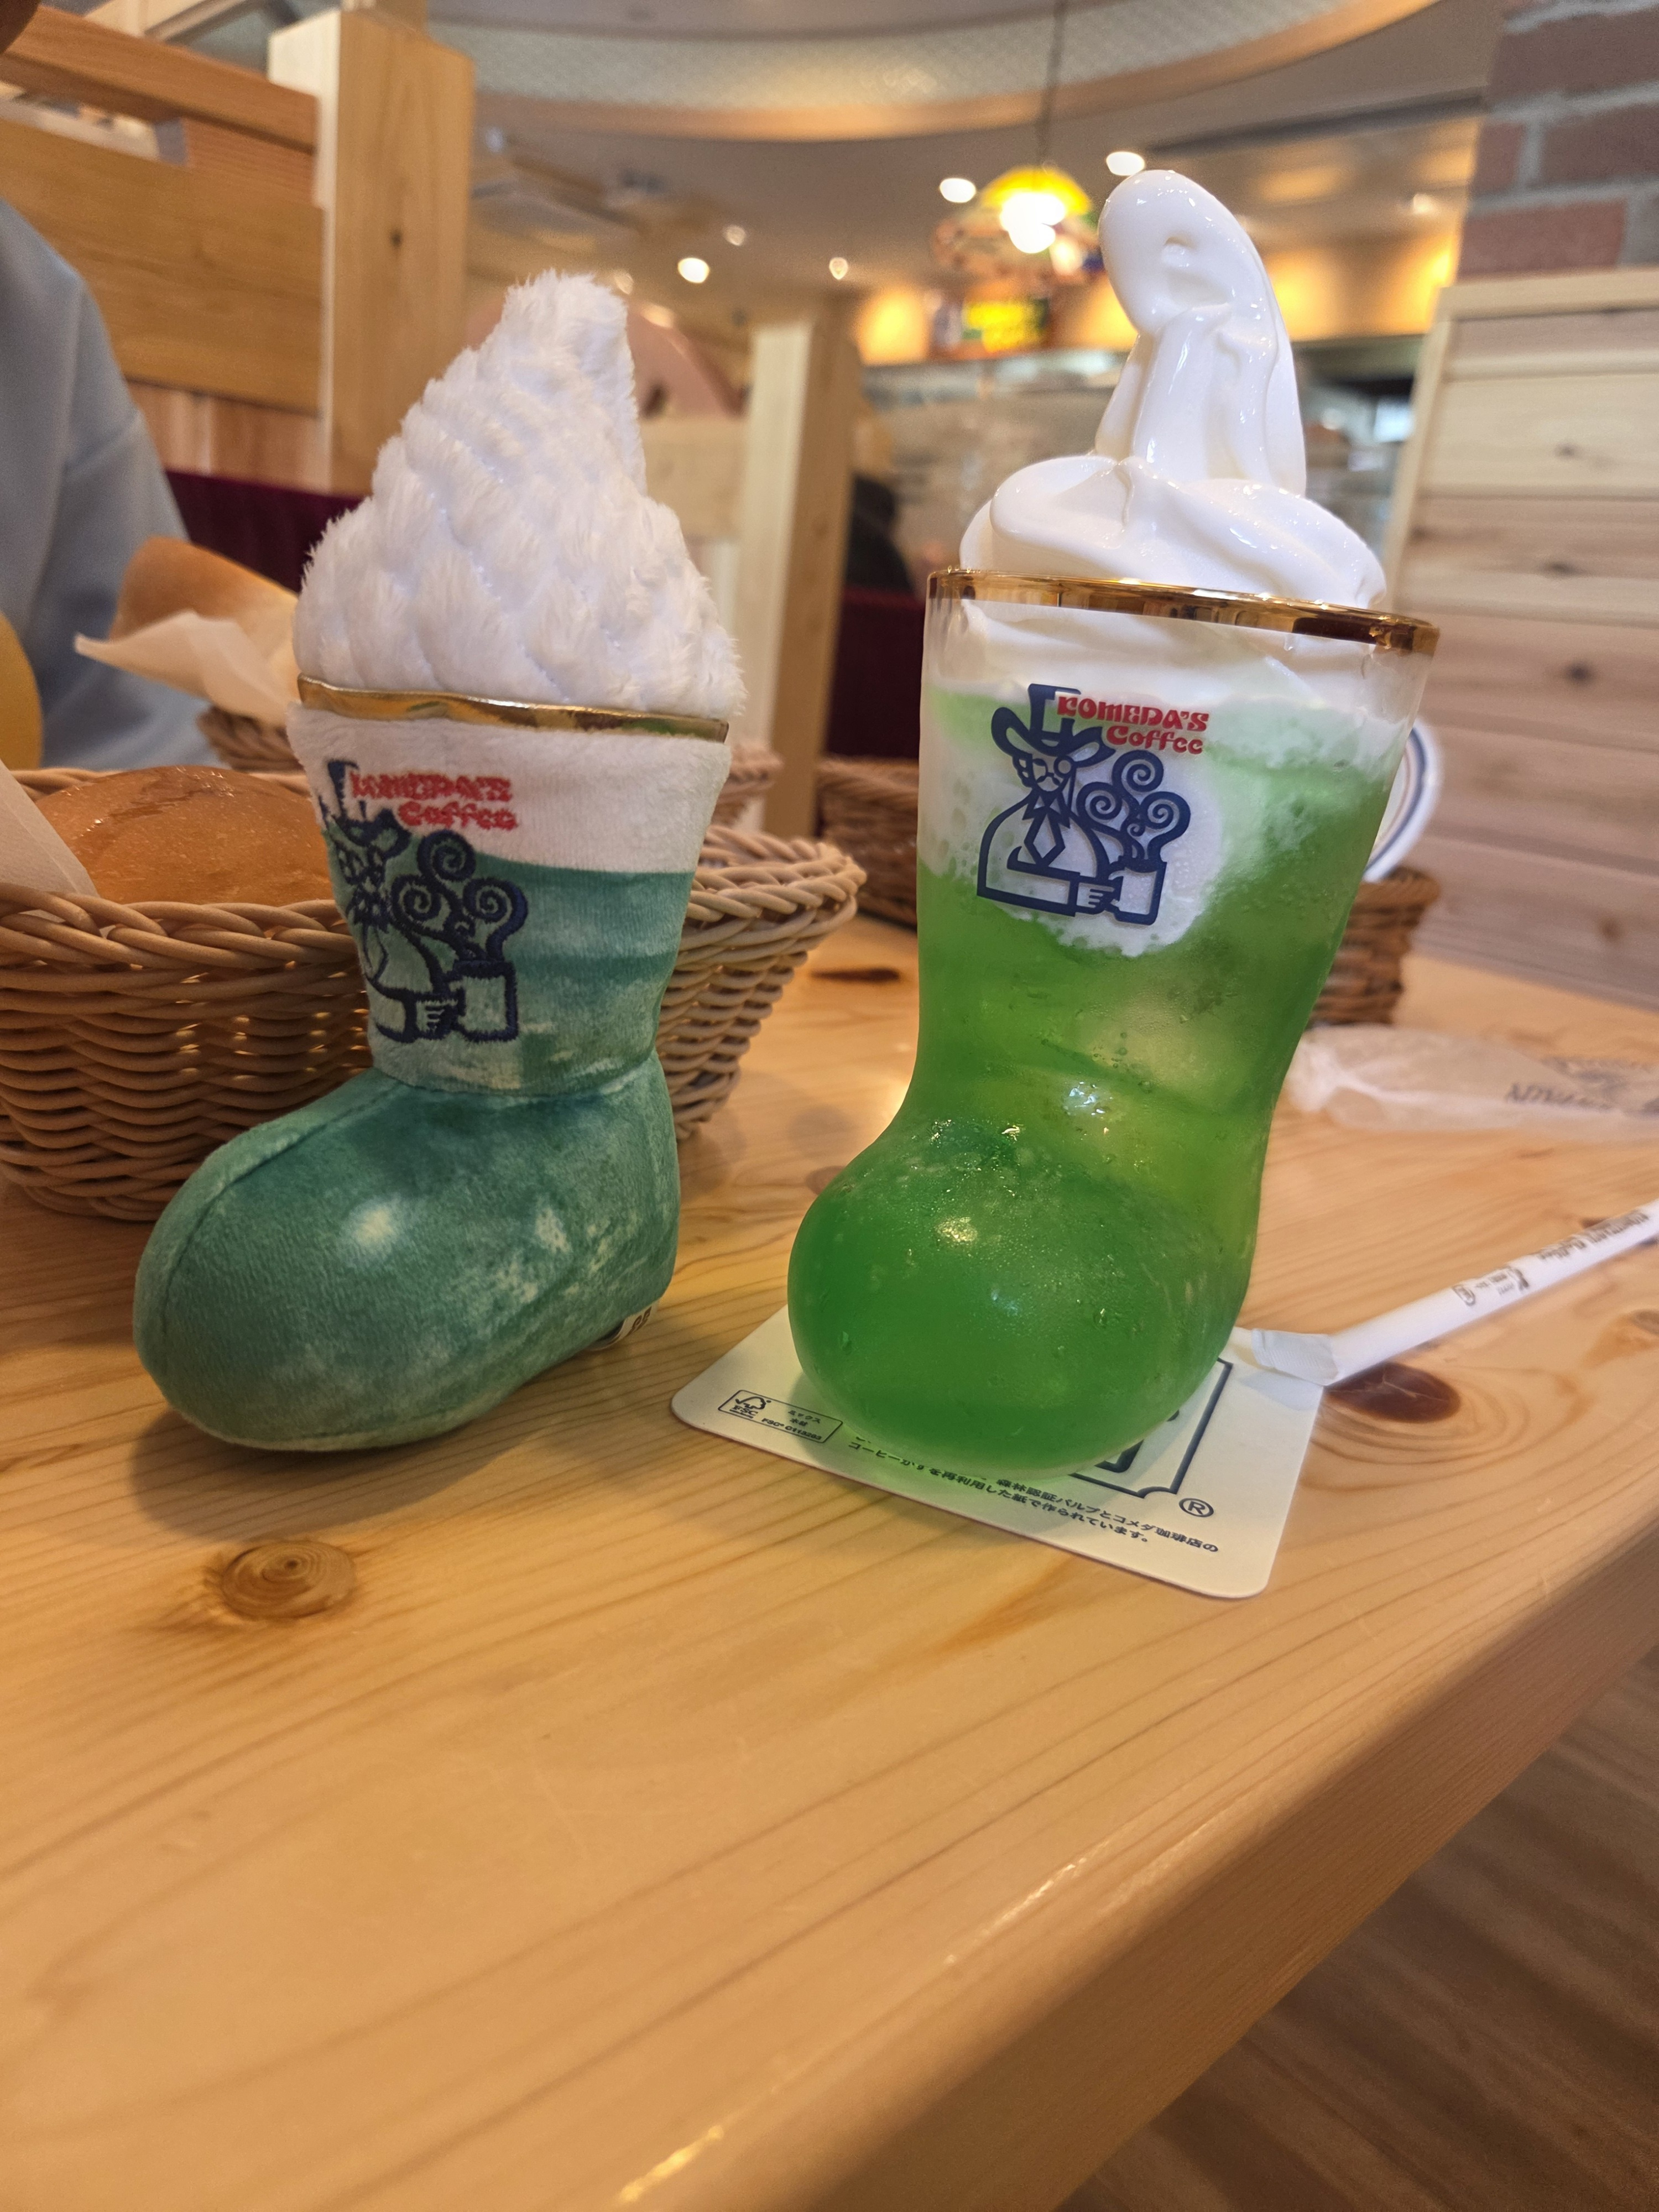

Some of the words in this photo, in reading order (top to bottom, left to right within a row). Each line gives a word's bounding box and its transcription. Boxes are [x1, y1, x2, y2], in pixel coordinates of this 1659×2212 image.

[1057, 696, 1209, 731] KOMEDA'S
[1107, 725, 1203, 754] Coffee
[398, 801, 518, 830] Coffee
